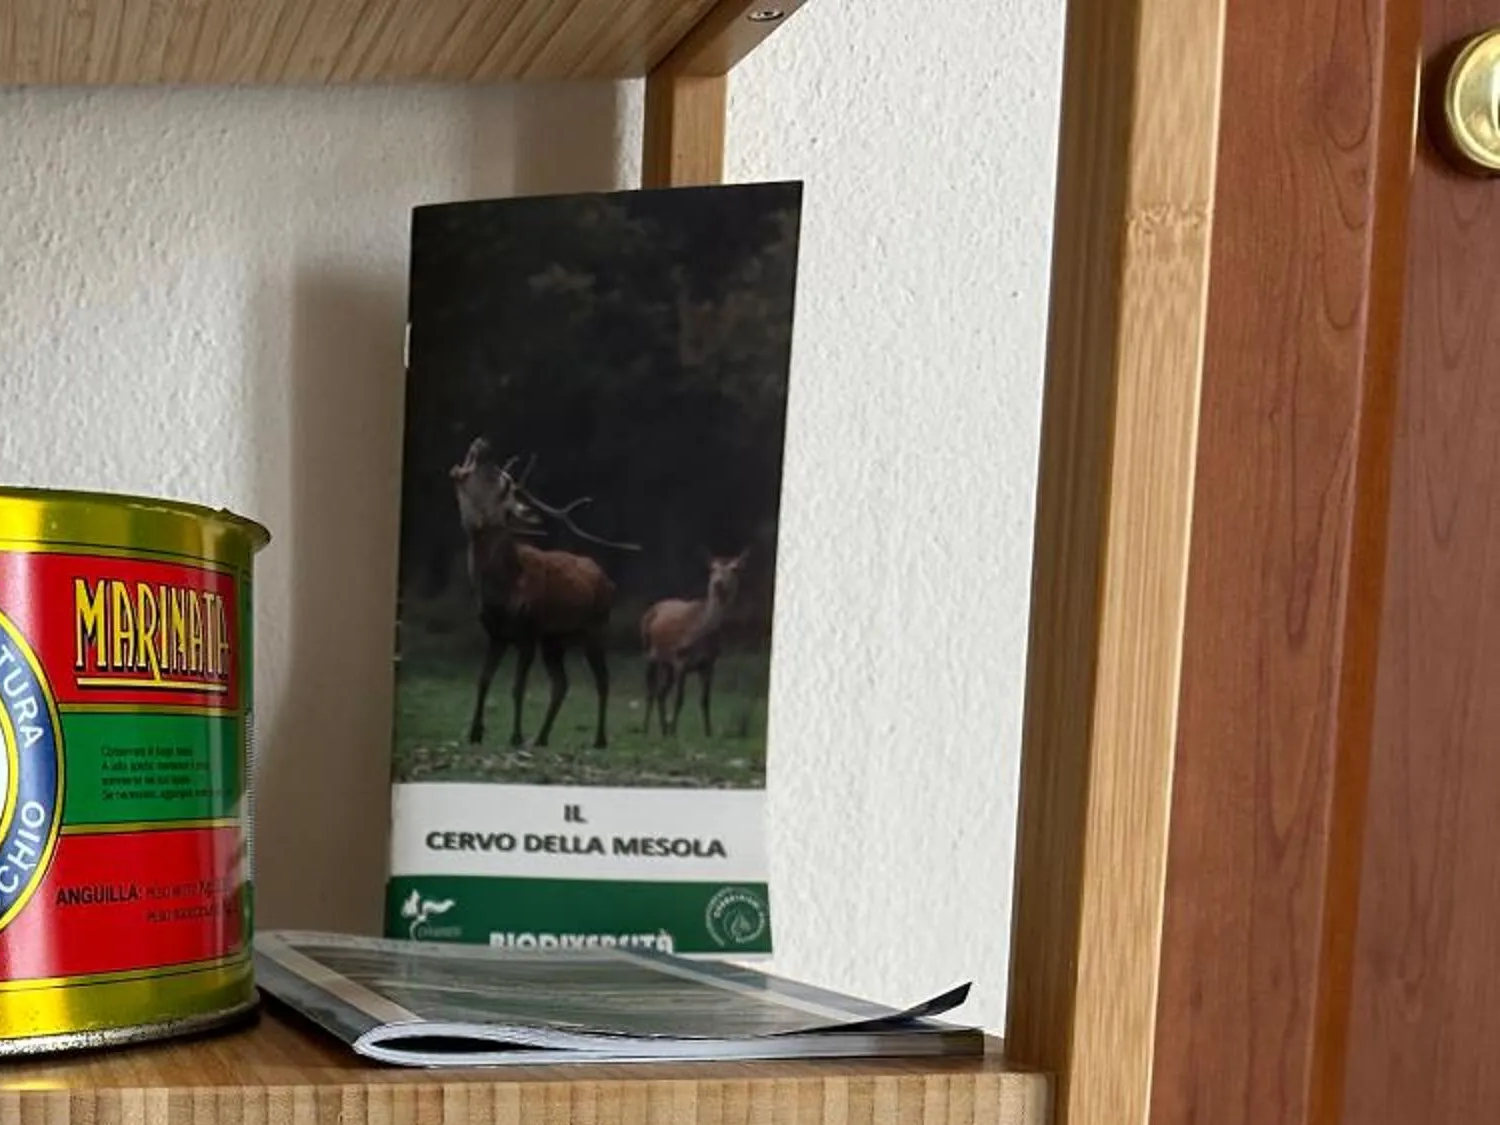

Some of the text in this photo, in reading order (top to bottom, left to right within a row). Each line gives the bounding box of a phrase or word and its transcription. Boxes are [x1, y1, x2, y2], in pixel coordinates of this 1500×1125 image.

[74, 577, 229, 690] MARINATA
[563, 804, 588, 824] IL
[426, 831, 727, 858] CERVO DELLA MESOLA
